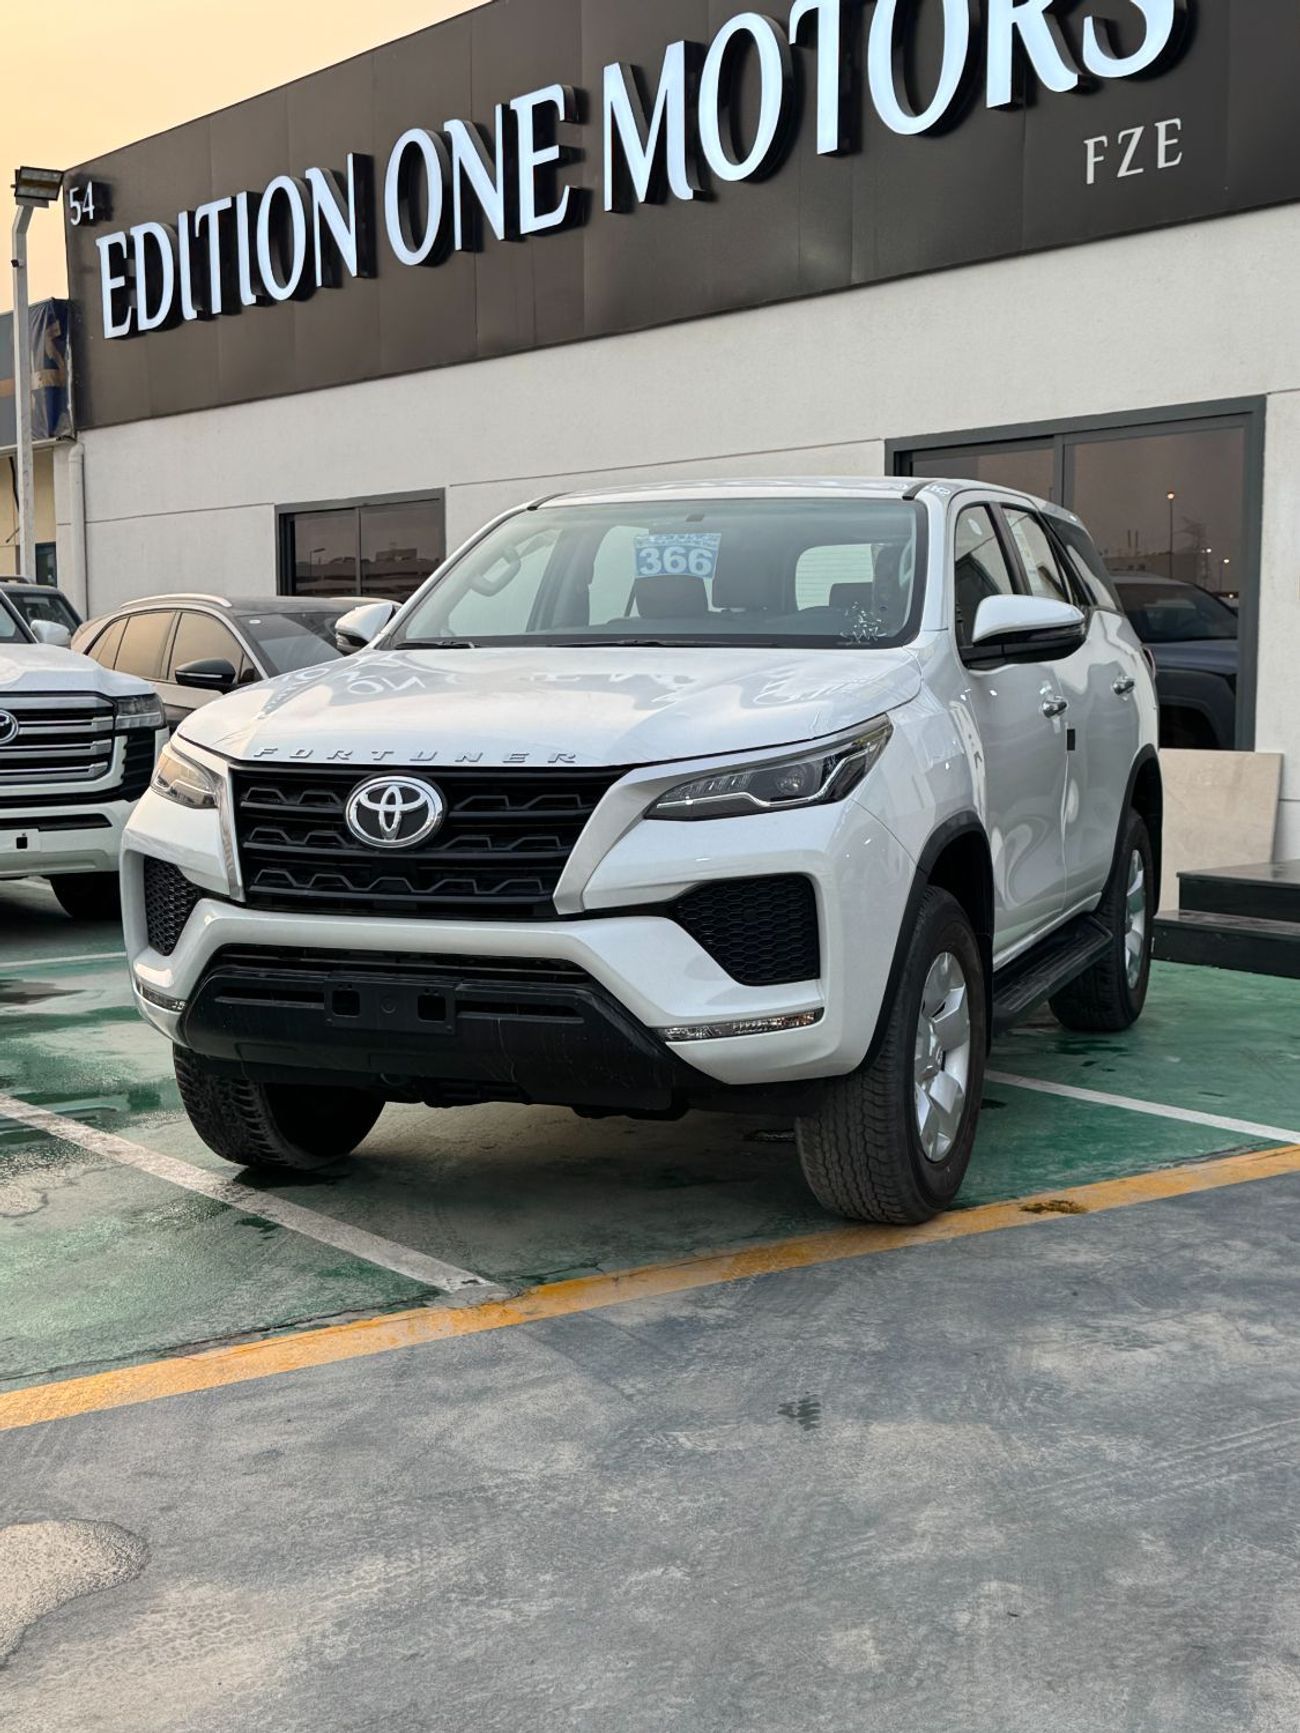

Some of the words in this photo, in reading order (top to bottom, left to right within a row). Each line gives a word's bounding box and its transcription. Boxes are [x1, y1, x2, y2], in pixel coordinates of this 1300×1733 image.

[1084, 118, 1184, 185] FZE
[69, 182, 96, 226] 54
[96, 153, 360, 340] EDITION
[384, 84, 576, 267] ONE
[639, 546, 713, 576] 366
[253, 747, 577, 764] FORTUNER
